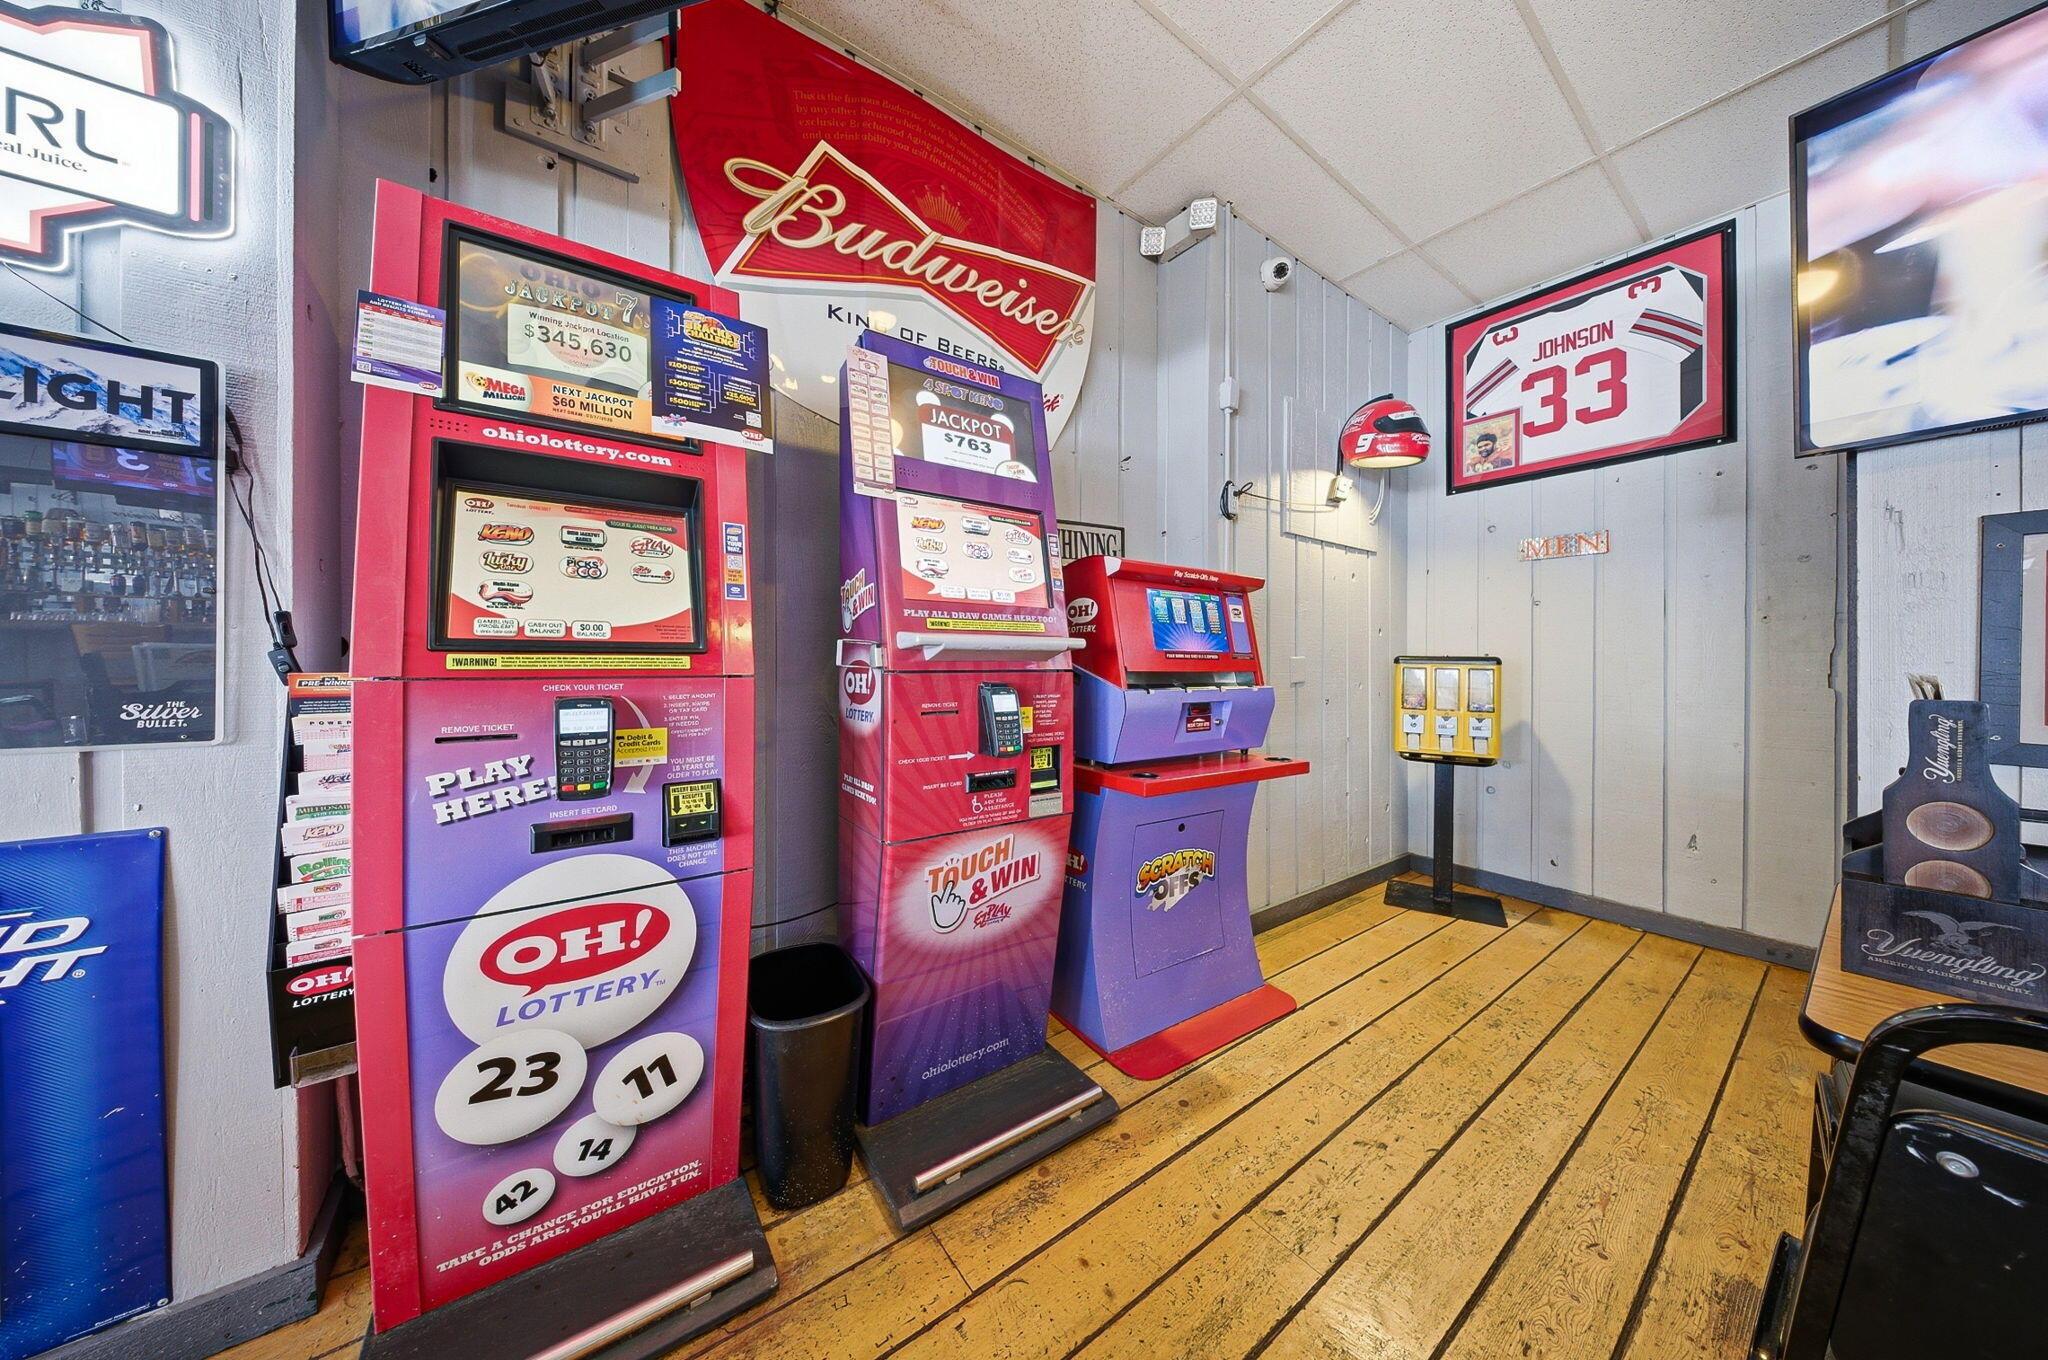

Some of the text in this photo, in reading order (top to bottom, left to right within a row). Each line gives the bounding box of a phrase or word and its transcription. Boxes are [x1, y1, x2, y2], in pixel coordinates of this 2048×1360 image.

[793, 89, 816, 100] This
[827, 92, 842, 101] the
[796, 103, 808, 114] by
[810, 105, 828, 115] any
[799, 117, 847, 128] exclusive
[906, 132, 932, 150] Aging
[893, 141, 910, 153] you
[27, 147, 88, 173] Juice.
[724, 156, 1086, 345] Budweiser
[1628, 275, 1662, 299] 3
[504, 279, 615, 320] JACKPOT
[528, 311, 630, 344] Winning Jackpot Location
[827, 303, 882, 330] KIN
[899, 326, 928, 344] OF
[524, 323, 633, 363] $345,630
[1532, 320, 1614, 363] JOHNSON
[929, 356, 1001, 389] TOUCH & WIN
[482, 389, 527, 402] MILLIONS
[485, 377, 527, 396] MEGA
[552, 385, 634, 410] NEXT JACKPOT
[923, 378, 934, 391] 4
[934, 380, 969, 400] SPOT
[1521, 347, 1628, 439] 33
[552, 395, 576, 409] $60
[579, 401, 633, 420] MILLION
[930, 408, 1001, 439] JACKPOT
[482, 426, 672, 467] ohiolottery.com
[944, 432, 992, 454] $763
[1355, 432, 1378, 454] 9
[478, 524, 534, 541] KENO
[1058, 529, 1118, 557] HINING
[1525, 530, 1601, 559] MEN
[482, 551, 529, 572] Lucky
[566, 559, 599, 569] PICKS
[903, 608, 1057, 624] PLAY ALL DRAW GAMES HERE TOO!
[1067, 601, 1095, 618] OH!
[529, 627, 562, 635] BALANCE
[580, 623, 604, 632] $0.00
[452, 657, 497, 668] !WARNING!
[542, 683, 624, 692] CHECK YOUR TICKET
[845, 667, 872, 695] OH!
[119, 702, 203, 721] Silver
[166, 700, 186, 708] THE
[846, 707, 873, 723] LOTTERY
[441, 723, 514, 734] REMOVE TICKET
[688, 756, 706, 764] MUST
[1923, 714, 1957, 784] Yuengling
[425, 754, 532, 797] PLAY
[666, 771, 690, 780] OLDER
[702, 768, 719, 777] PLAY
[681, 764, 705, 772] YEARS
[671, 784, 713, 795] INSERT BILL HERE
[983, 791, 1003, 799] PLEASE
[550, 805, 617, 819] INSERT BETCARD
[983, 802, 1015, 812] ASSISTANCE
[302, 823, 345, 841] KENO
[667, 849, 718, 863] DOES NOT GIVE
[668, 842, 717, 855] THIS MACHINE
[678, 857, 708, 868] CHANGE
[927, 837, 1012, 893] TOUCH
[1137, 850, 1215, 891] SCRATCH
[969, 857, 1037, 905] & WIN
[1152, 871, 1201, 900] OFFS
[0, 916, 90, 954] D
[495, 908, 653, 975] OH!
[1861, 928, 2047, 987] Yuengling
[290, 966, 353, 992] OH!
[1867, 955, 2034, 996] AMERICA'S OLDEST BREWERY.
[293, 987, 355, 1008] LOTTERY
[495, 968, 661, 1027] LOTTERY
[921, 1036, 1009, 1080] ohiolottery.com
[468, 1051, 561, 1106] 23
[621, 1053, 678, 1101] 11
[578, 1138, 613, 1162] 14
[495, 1179, 539, 1216] 42
[436, 1159, 702, 1273] TAKE A CHANCE FOR EDUCATION.
[478, 1169, 702, 1268] ODDS ARE, YOU'LL HAVE FUN.
